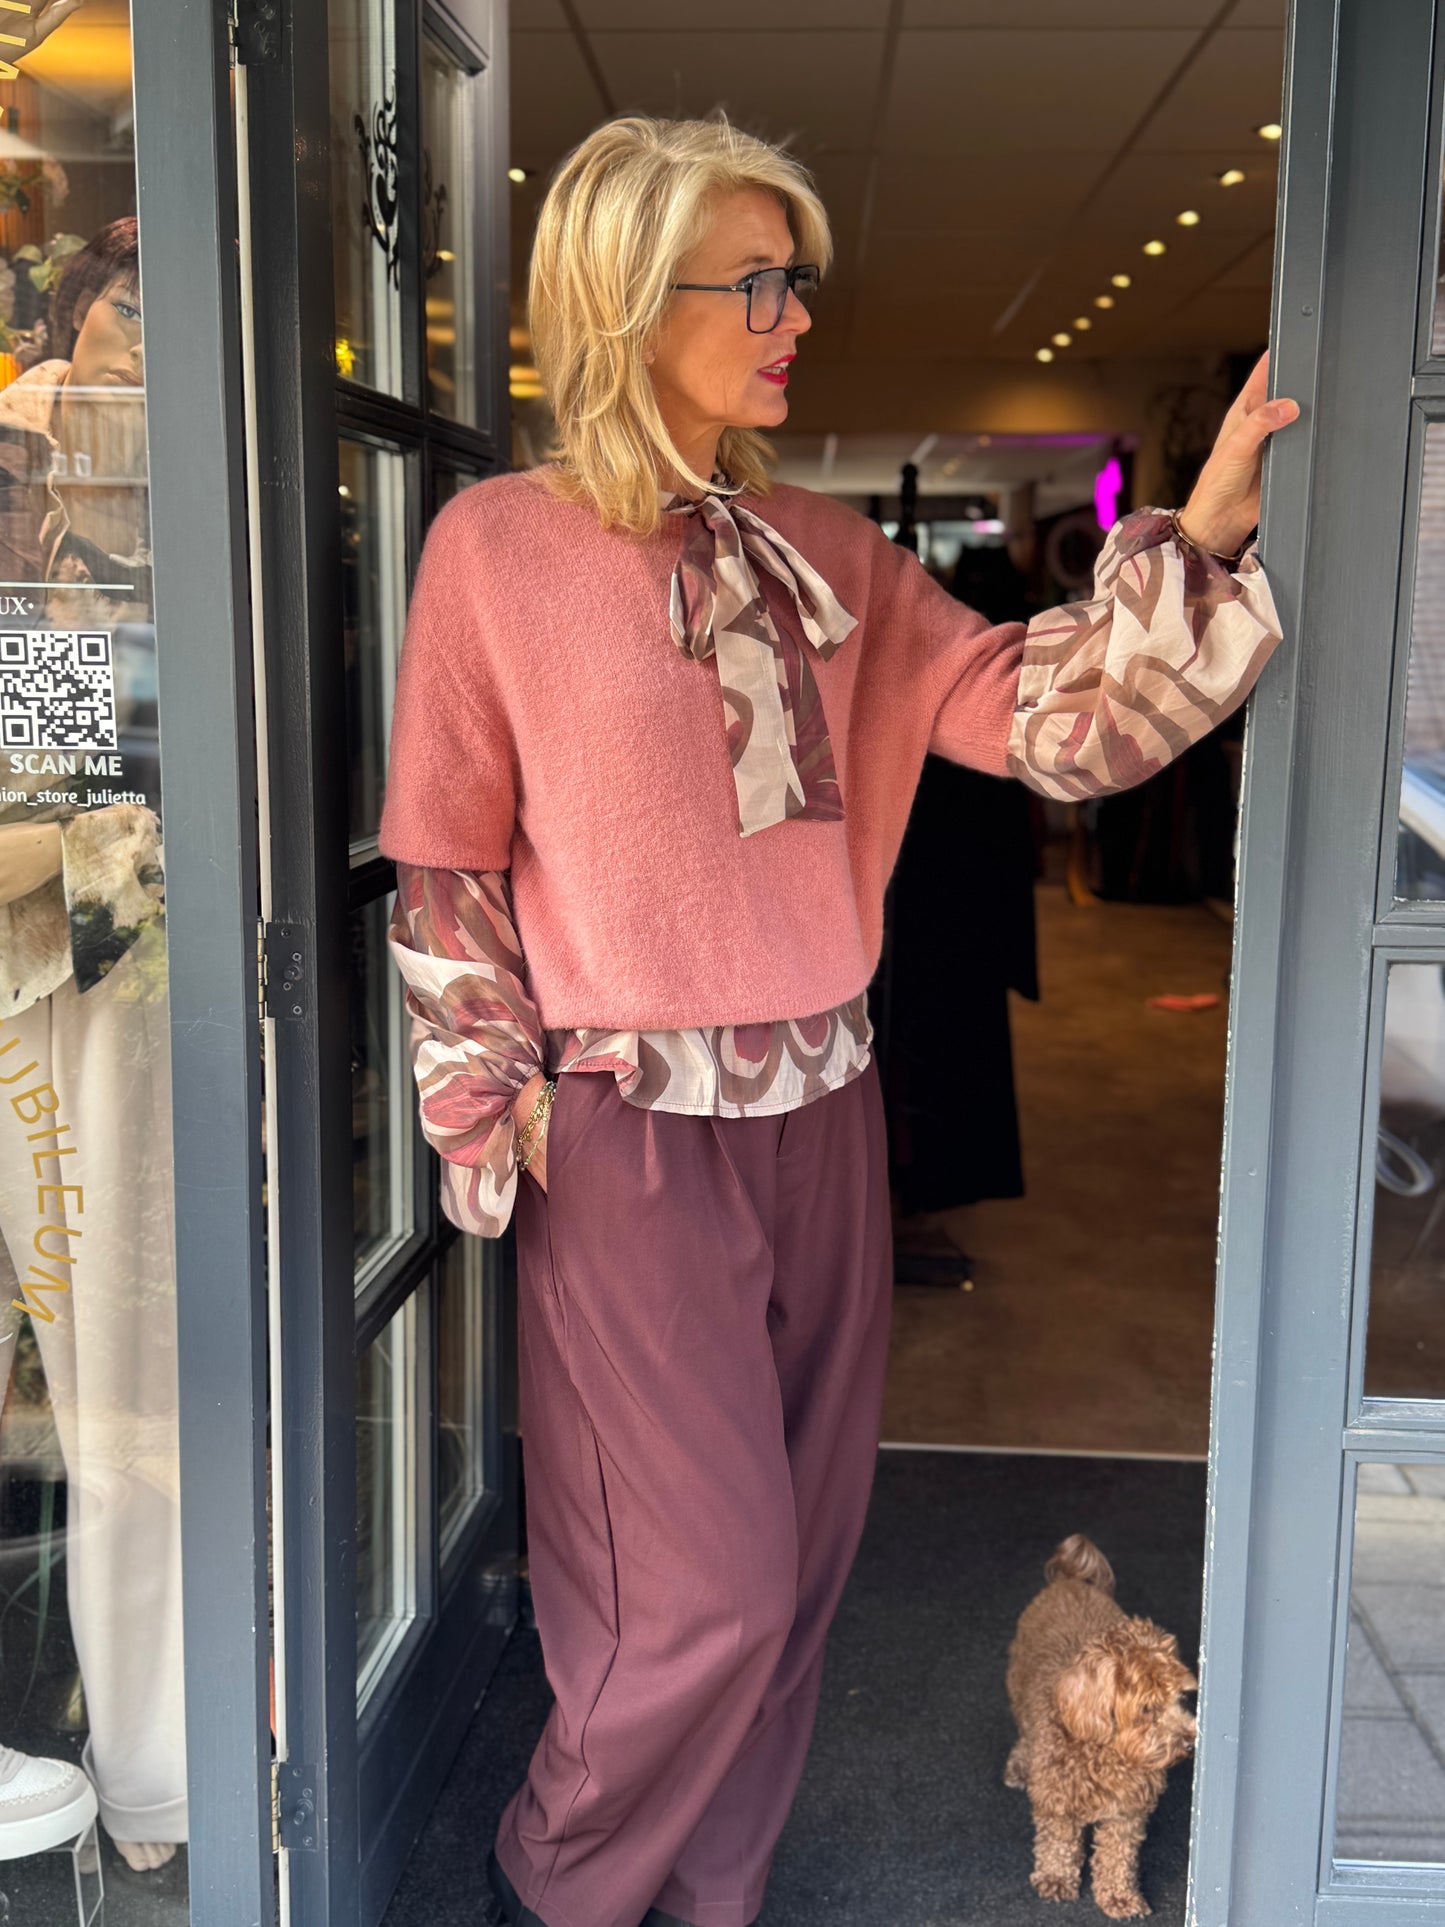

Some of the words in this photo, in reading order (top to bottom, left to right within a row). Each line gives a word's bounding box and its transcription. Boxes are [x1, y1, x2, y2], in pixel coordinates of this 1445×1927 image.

[9, 753, 77, 775] SCAN
[84, 755, 123, 776] ME
[0, 787, 146, 807] ion_store_julietta
[0, 1020, 84, 1324] UBILEUM
